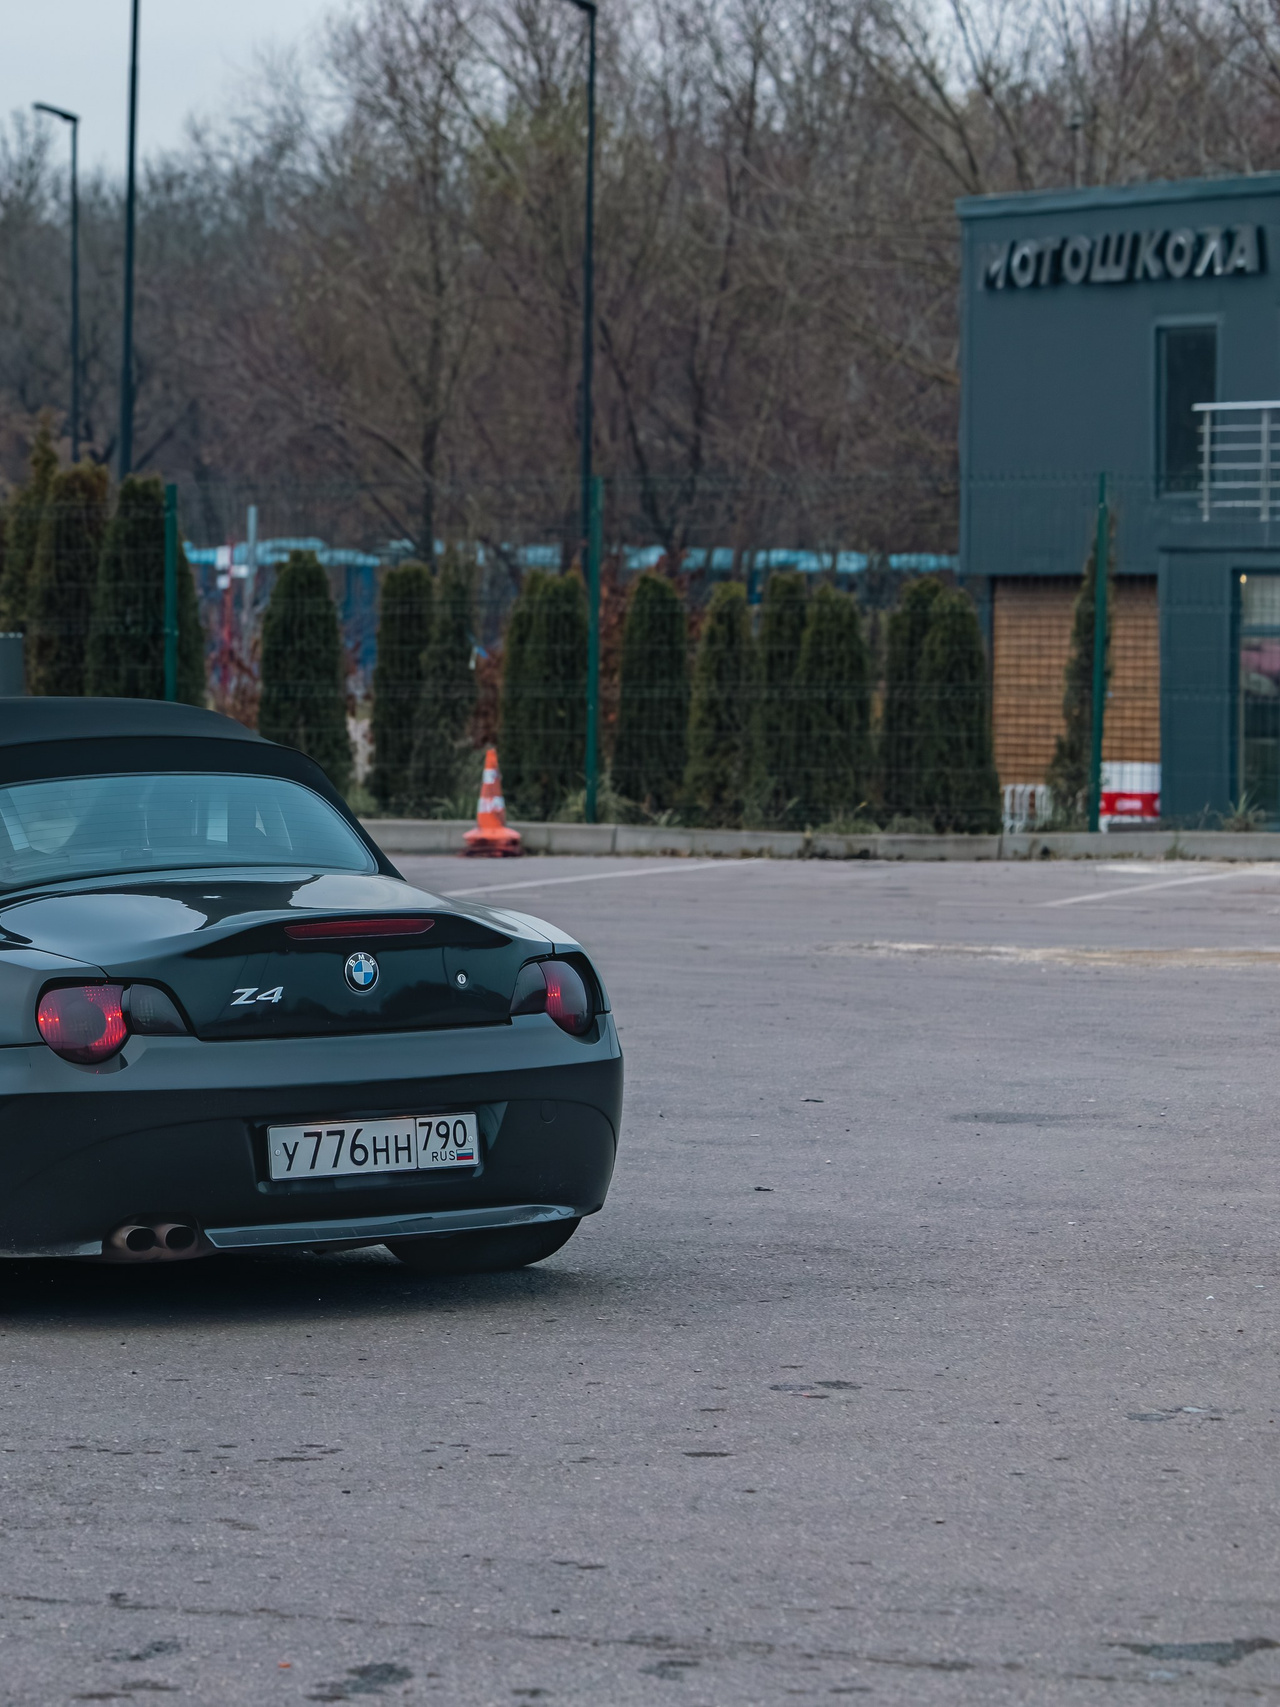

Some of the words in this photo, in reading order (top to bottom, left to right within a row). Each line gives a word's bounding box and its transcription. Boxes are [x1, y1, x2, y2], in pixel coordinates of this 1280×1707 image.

[977, 223, 1266, 290] МОТОШКОЛА
[348, 954, 376, 967] BMW
[230, 986, 284, 1006] Z4
[418, 1119, 468, 1151] 790
[431, 1150, 456, 1162] RUS
